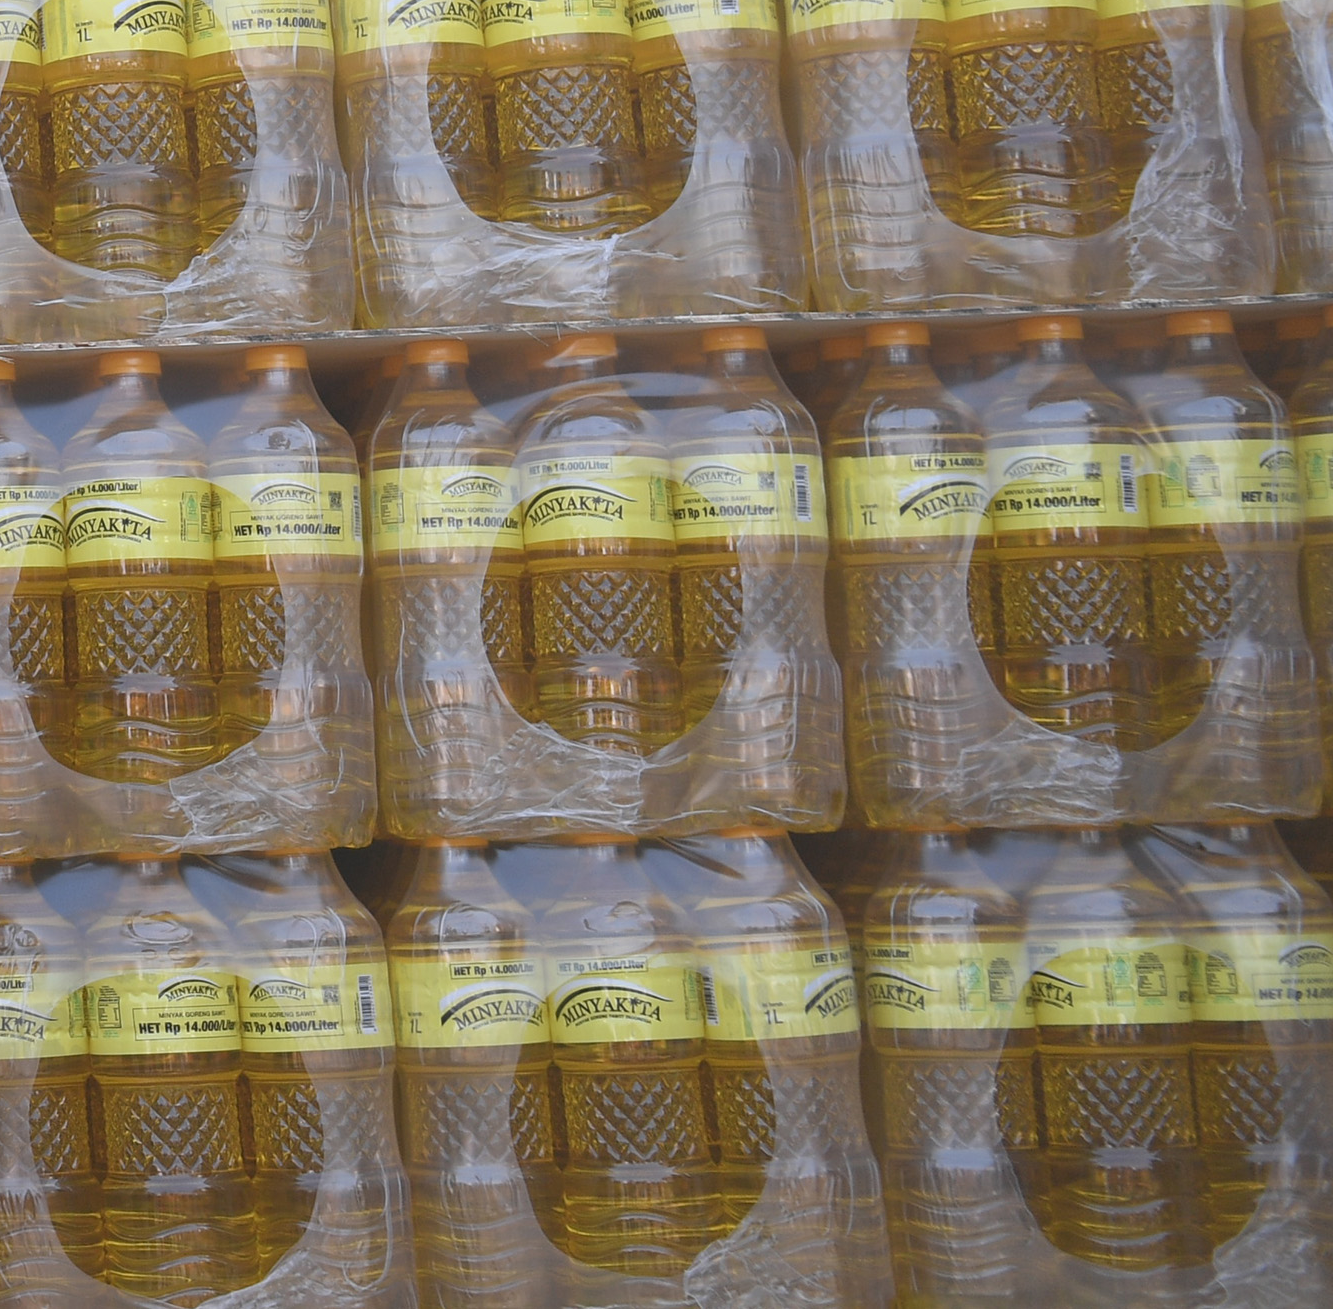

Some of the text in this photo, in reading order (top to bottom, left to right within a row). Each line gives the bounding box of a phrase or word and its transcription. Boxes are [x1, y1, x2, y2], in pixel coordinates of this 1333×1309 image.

[232, 17, 272, 30] HET Rp
[555, 459, 609, 473] 14.000/Liter
[527, 495, 625, 524] MINYAKITA
[1010, 494, 1101, 511] Rp 14.000/Liter
[688, 505, 774, 521] Rp 14.000/Liter
[862, 512, 877, 526] 1L
[234, 523, 271, 538] HET Rp
[164, 985, 219, 1000] MINYAKITA
[563, 996, 662, 1027] MINYAKITA
[764, 1010, 783, 1025] 1L
[139, 1021, 181, 1036] HET Rp
[269, 1020, 339, 1033] 14.000/Liter
